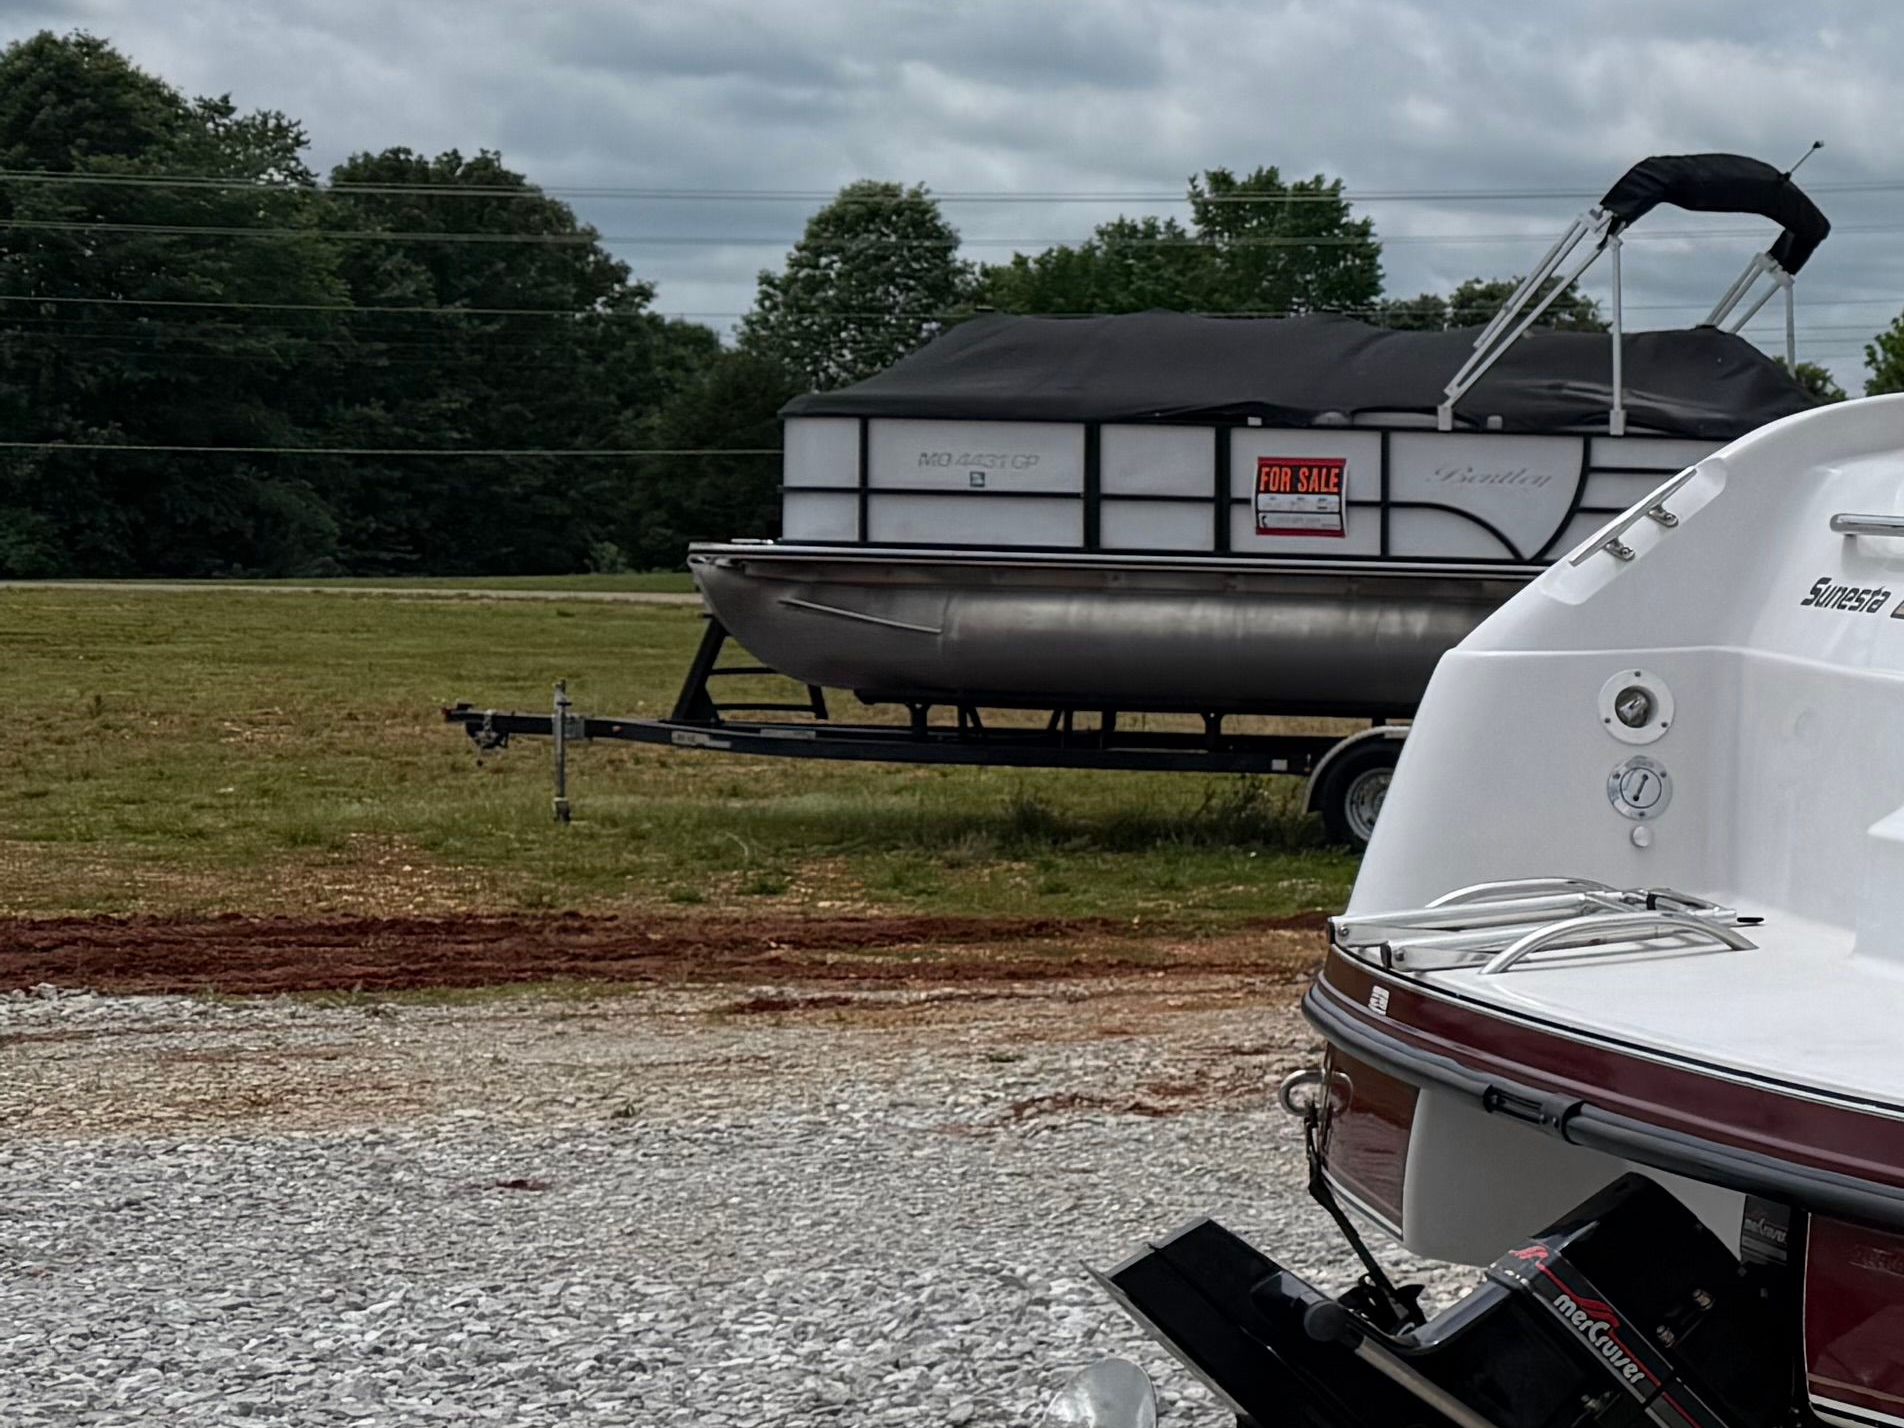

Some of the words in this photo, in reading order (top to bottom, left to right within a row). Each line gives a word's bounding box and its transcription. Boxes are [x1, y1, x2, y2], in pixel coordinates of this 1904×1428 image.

[918, 452, 952, 468] MO
[1260, 466, 1292, 492] FOR
[1297, 466, 1340, 493] SALE
[1800, 576, 1891, 614] Sunesta
